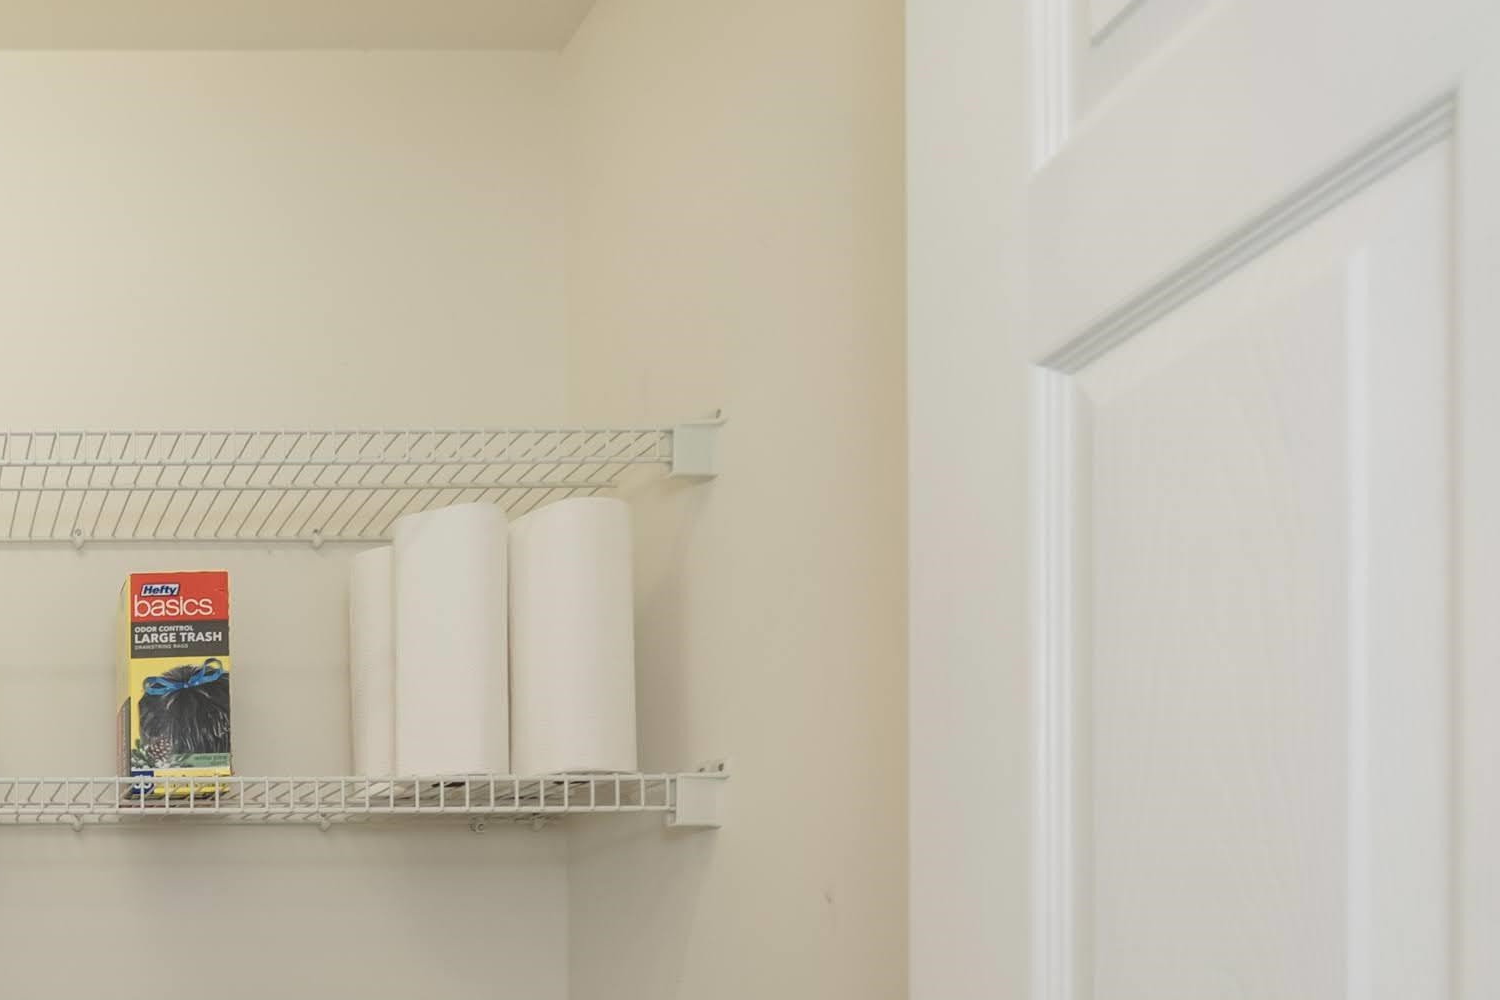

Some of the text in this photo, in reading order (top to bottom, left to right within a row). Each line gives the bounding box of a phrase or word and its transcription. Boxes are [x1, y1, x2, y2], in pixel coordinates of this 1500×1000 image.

[142, 585, 177, 596] Hefty
[134, 631, 223, 644] LARGE TRASH
